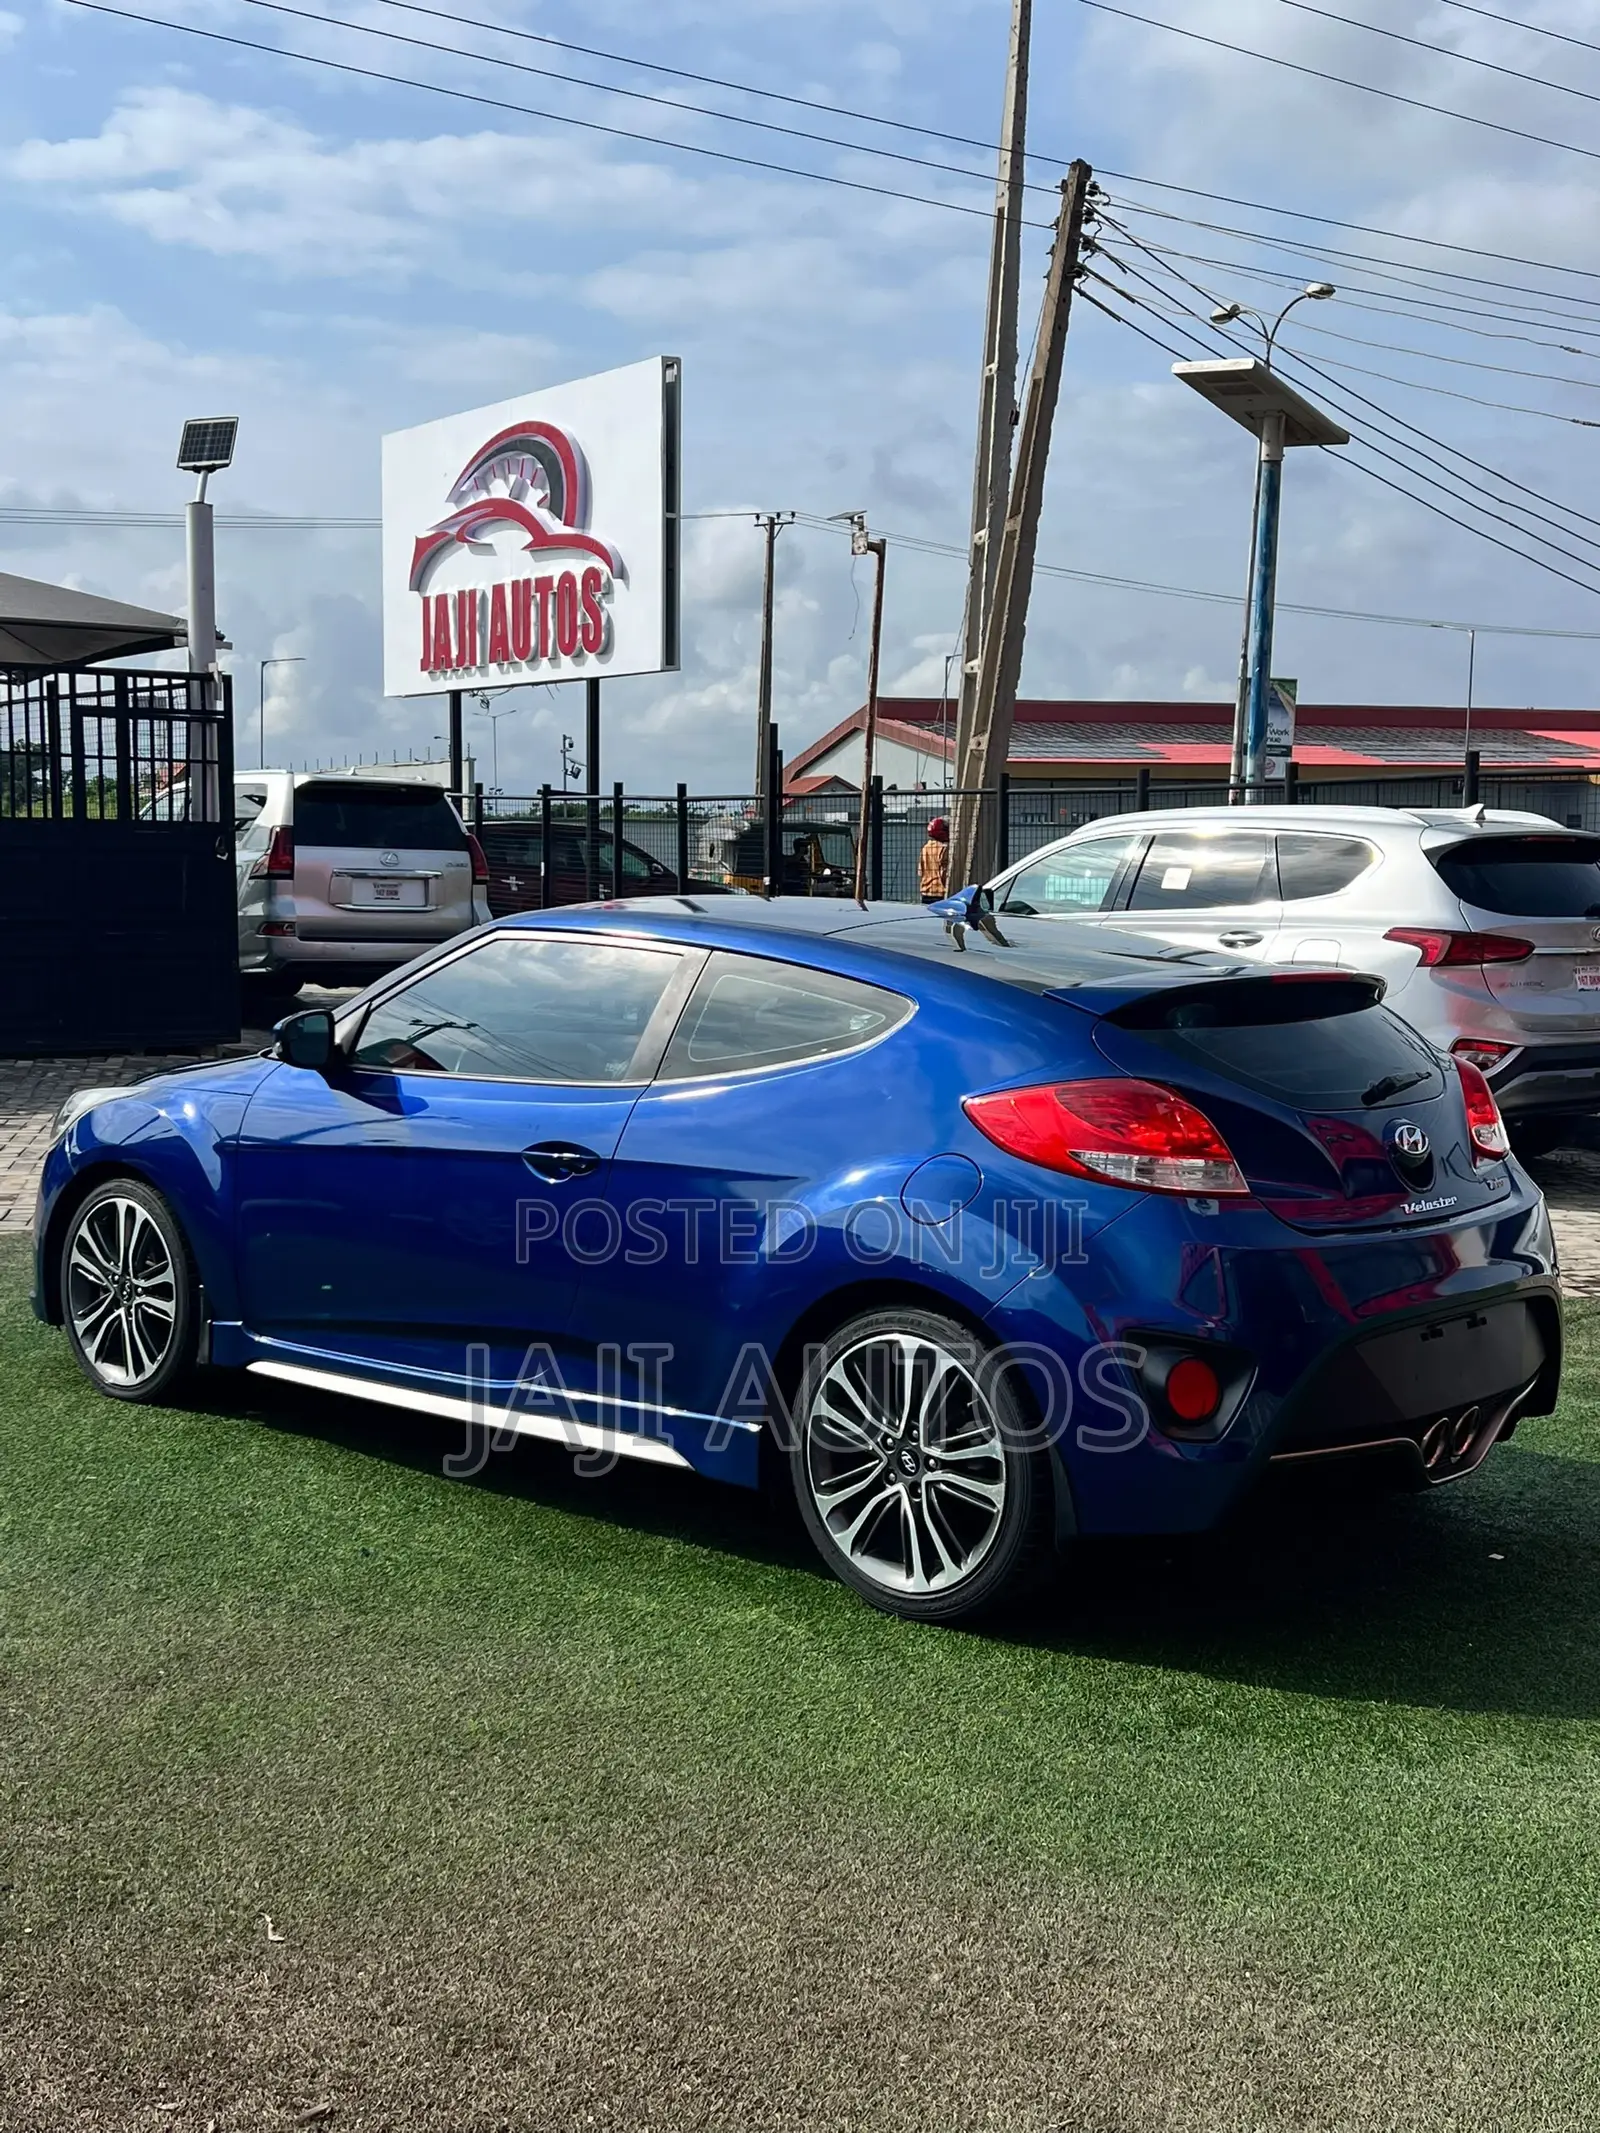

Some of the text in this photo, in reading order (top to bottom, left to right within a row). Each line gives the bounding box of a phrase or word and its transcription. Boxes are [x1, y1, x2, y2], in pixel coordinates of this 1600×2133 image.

[420, 566, 603, 672] JAJI AUTOS
[1269, 728, 1290, 736] Work
[1400, 1196, 1457, 1215] Veloster
